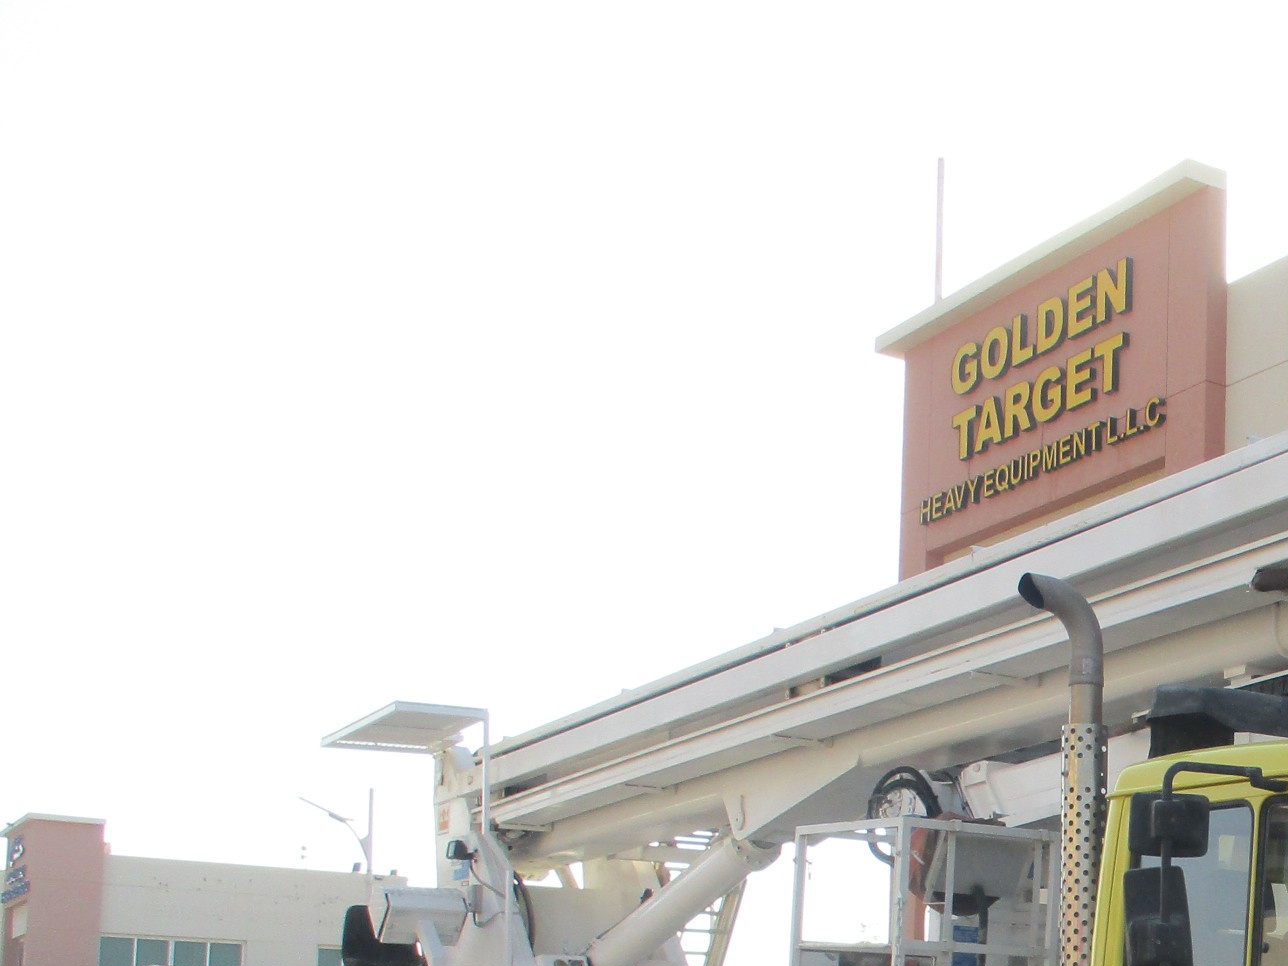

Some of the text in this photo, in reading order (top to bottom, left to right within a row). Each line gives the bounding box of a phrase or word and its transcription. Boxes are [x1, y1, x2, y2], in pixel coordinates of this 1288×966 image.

[951, 257, 1131, 395] GOLDEN
[952, 333, 1128, 460] TARGET
[920, 397, 1163, 524] HEAVY EQUIPMENT L.L.C
